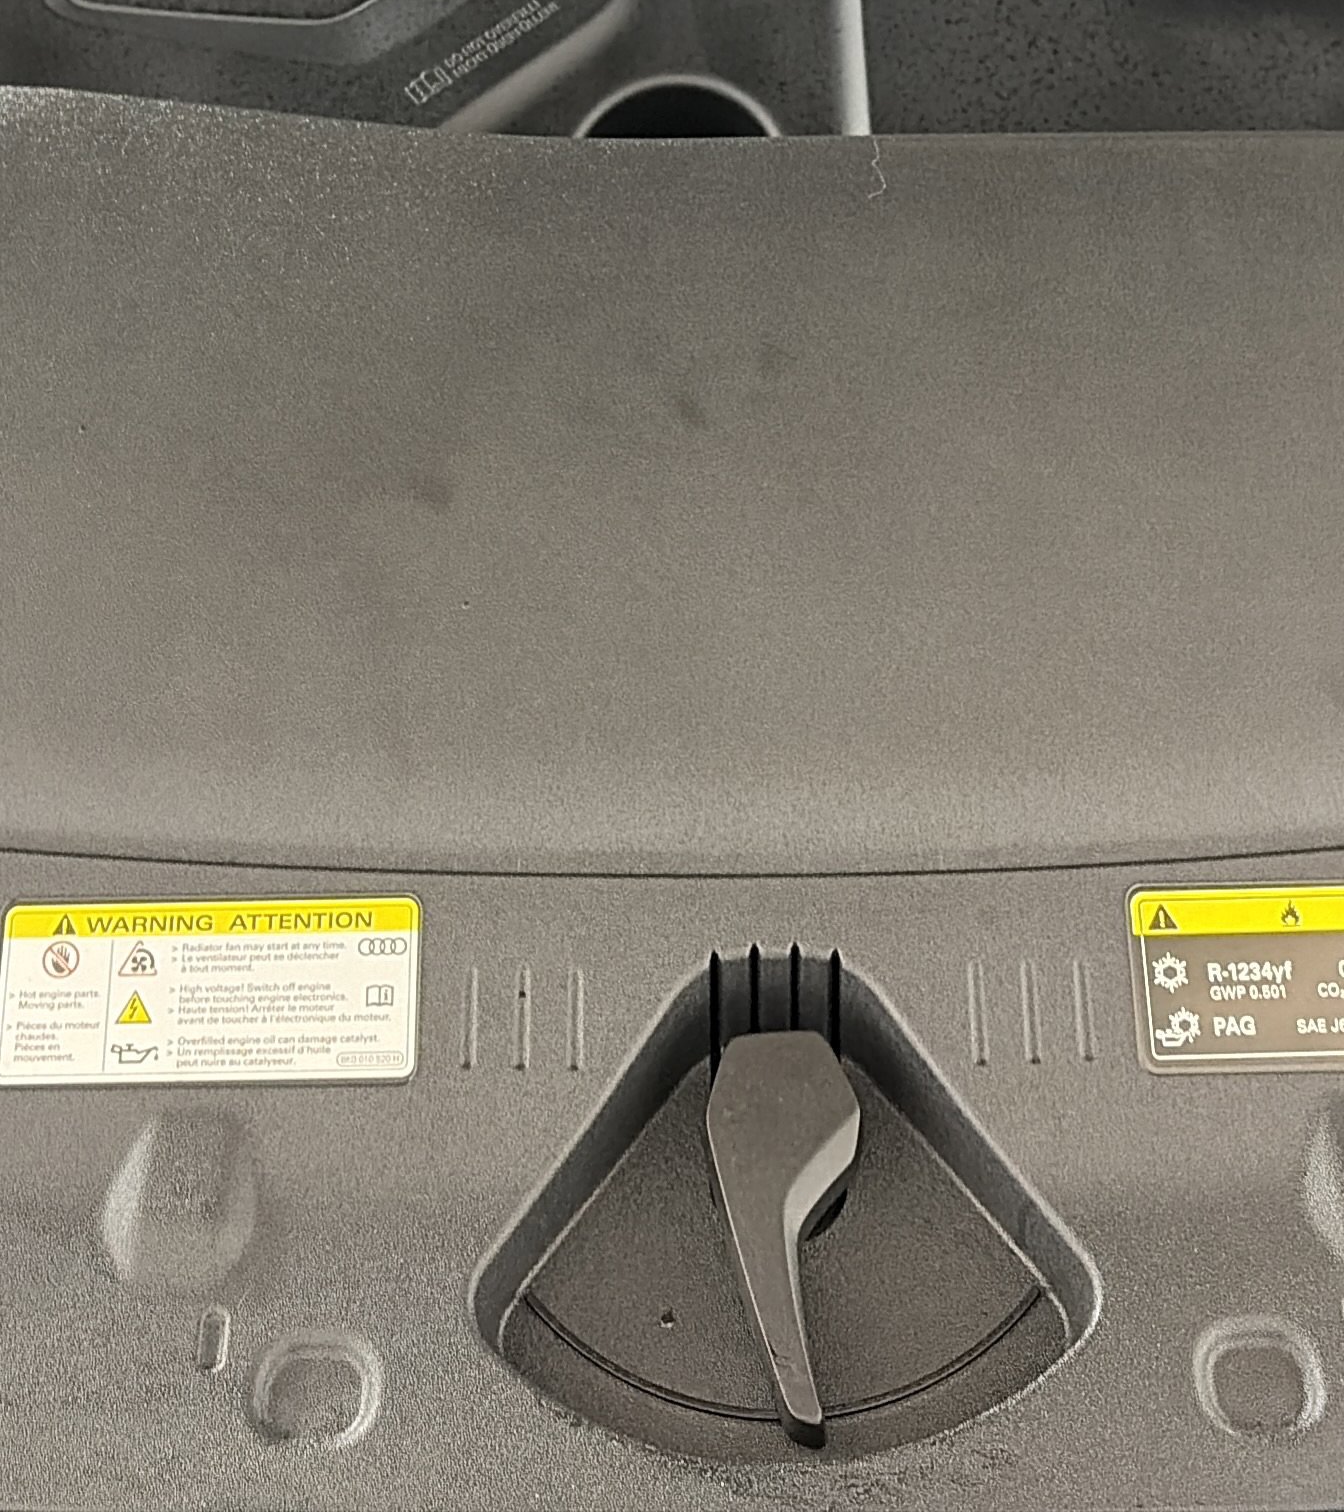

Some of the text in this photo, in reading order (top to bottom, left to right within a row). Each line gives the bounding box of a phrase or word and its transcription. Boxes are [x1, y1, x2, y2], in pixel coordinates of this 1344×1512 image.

[87, 911, 373, 934] WARNING ATTENTION
[182, 943, 223, 953] Radiator
[225, 942, 241, 951] fan
[267, 942, 289, 951] start
[291, 942, 300, 951] at
[196, 953, 248, 963] ventilateur
[249, 953, 271, 964] peut
[189, 964, 209, 973] tout
[1207, 960, 1293, 984] R-1234yf
[179, 984, 203, 995] High
[282, 982, 296, 991] off
[297, 982, 331, 993] engine
[1209, 984, 1287, 1001] GWP 0.501
[19, 990, 36, 999] Hot
[38, 989, 72, 1000] engine
[178, 994, 210, 1004] before
[212, 994, 255, 1004] touching
[257, 994, 291, 1004] engine
[18, 1000, 55, 1011] Moving
[178, 1005, 207, 1015] Haute
[287, 1004, 297, 1012] le
[299, 1004, 334, 1012] moteur
[177, 1016, 205, 1025] avant
[207, 1015, 220, 1024] de
[221, 1015, 259, 1024] toucher
[338, 1013, 351, 1022] du
[49, 1020, 63, 1030] du
[64, 1021, 101, 1030] moteur
[1213, 1015, 1257, 1037] PAG
[1296, 1018, 1328, 1034] SAE
[177, 1035, 226, 1046] Overfilled
[227, 1035, 261, 1047] engine
[263, 1035, 276, 1044] oil
[278, 1036, 296, 1044] can
[297, 1034, 338, 1045] damage
[47, 1043, 60, 1051] en
[176, 1047, 192, 1057] Un
[194, 1046, 254, 1058] remplissage
[176, 1059, 198, 1069] peut
[200, 1058, 226, 1067] nuire
